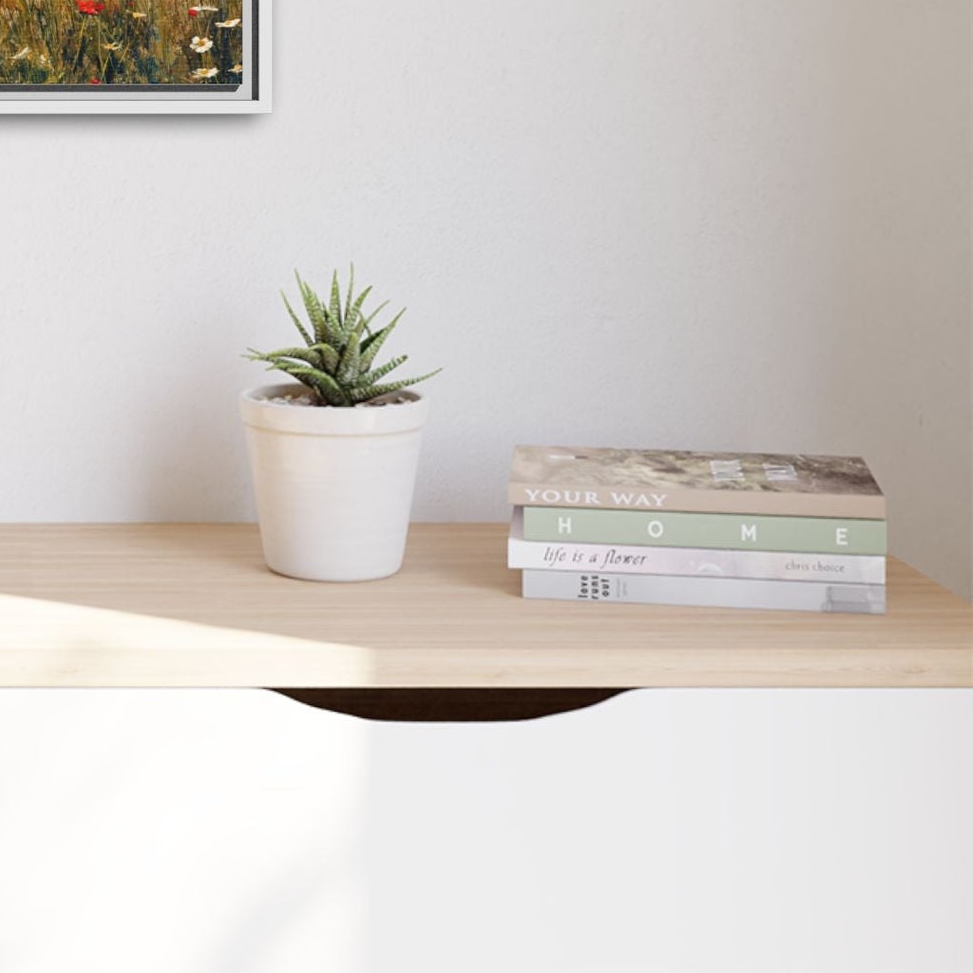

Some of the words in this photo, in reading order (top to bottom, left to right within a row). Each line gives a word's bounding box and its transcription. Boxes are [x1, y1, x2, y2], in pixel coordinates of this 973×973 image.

[525, 489, 601, 505] YOUR
[611, 491, 668, 507] WAY
[543, 547, 567, 567] life
[572, 550, 584, 563] is
[589, 553, 597, 564] a
[599, 549, 648, 569] flower
[812, 559, 846, 574] choice
[577, 575, 589, 598] love
[590, 575, 599, 600] runs
[600, 578, 611, 597] out
